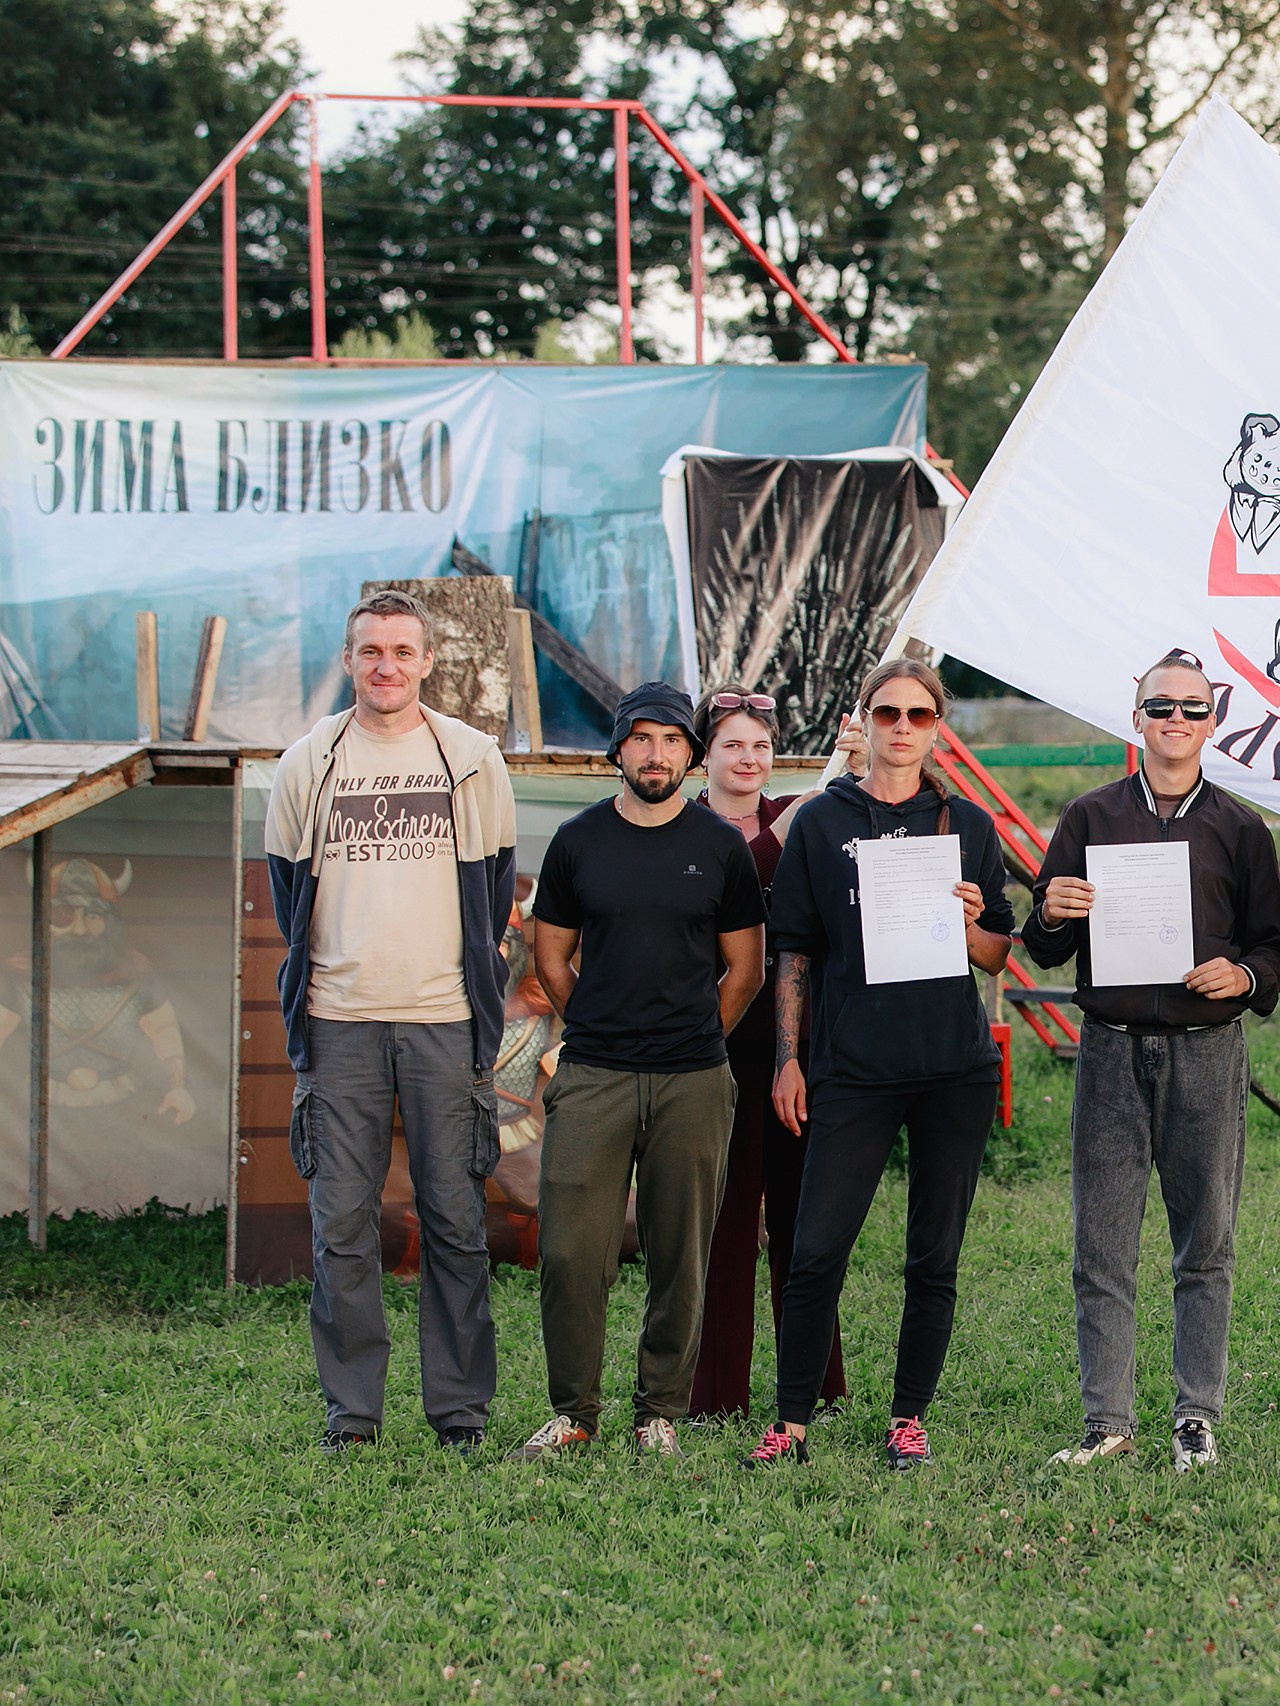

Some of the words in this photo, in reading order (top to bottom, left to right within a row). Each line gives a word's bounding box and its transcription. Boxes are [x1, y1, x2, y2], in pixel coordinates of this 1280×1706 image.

[32, 416, 192, 516] ЗИМА
[213, 417, 453, 515] БЛИЗКО
[372, 775, 400, 790] FOR
